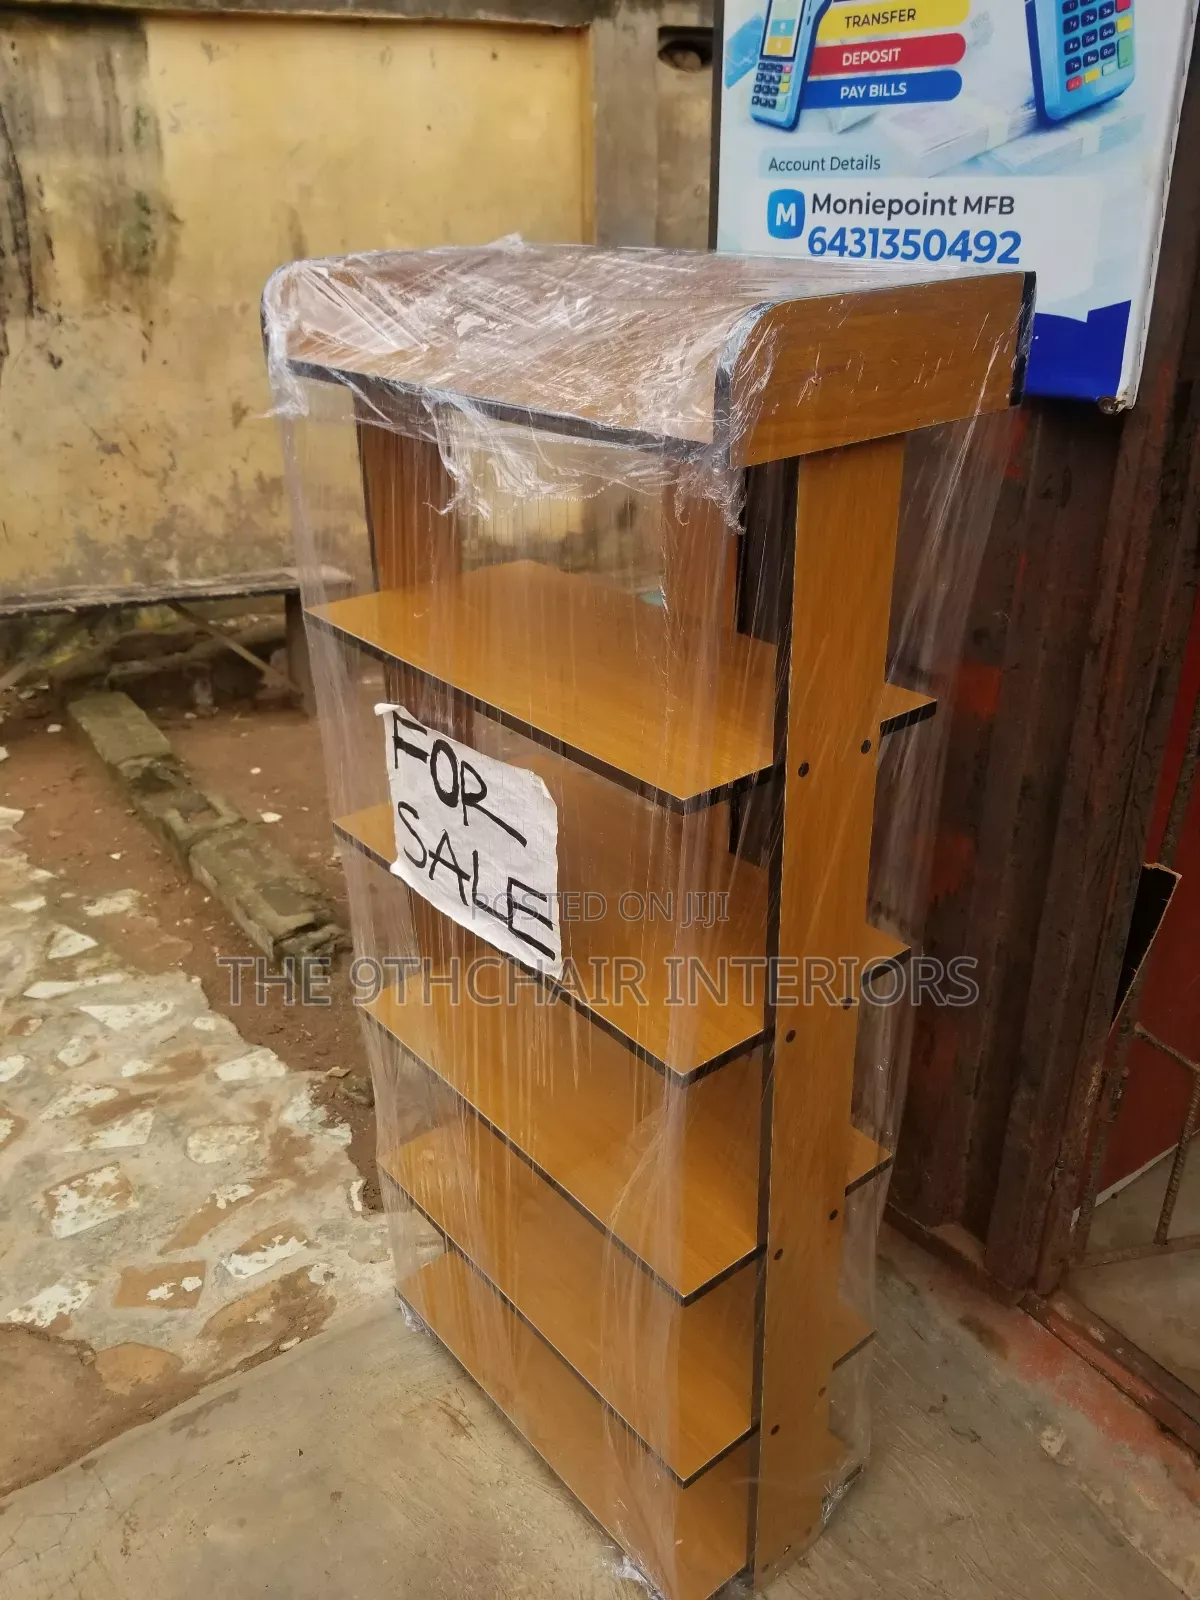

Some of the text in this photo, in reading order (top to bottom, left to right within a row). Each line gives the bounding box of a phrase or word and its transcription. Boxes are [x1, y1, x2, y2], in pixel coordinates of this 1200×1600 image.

[844, 8, 917, 29] TRANSFER
[842, 47, 901, 67] DEPOSIT
[840, 82, 907, 100] PAY BILLS
[768, 154, 881, 172] Account Details
[776, 202, 797, 227] M
[811, 191, 1015, 221] Moniepoint MFB
[807, 225, 1022, 265] 6431350492
[392, 710, 528, 848] FOR
[397, 801, 556, 962] SALE
